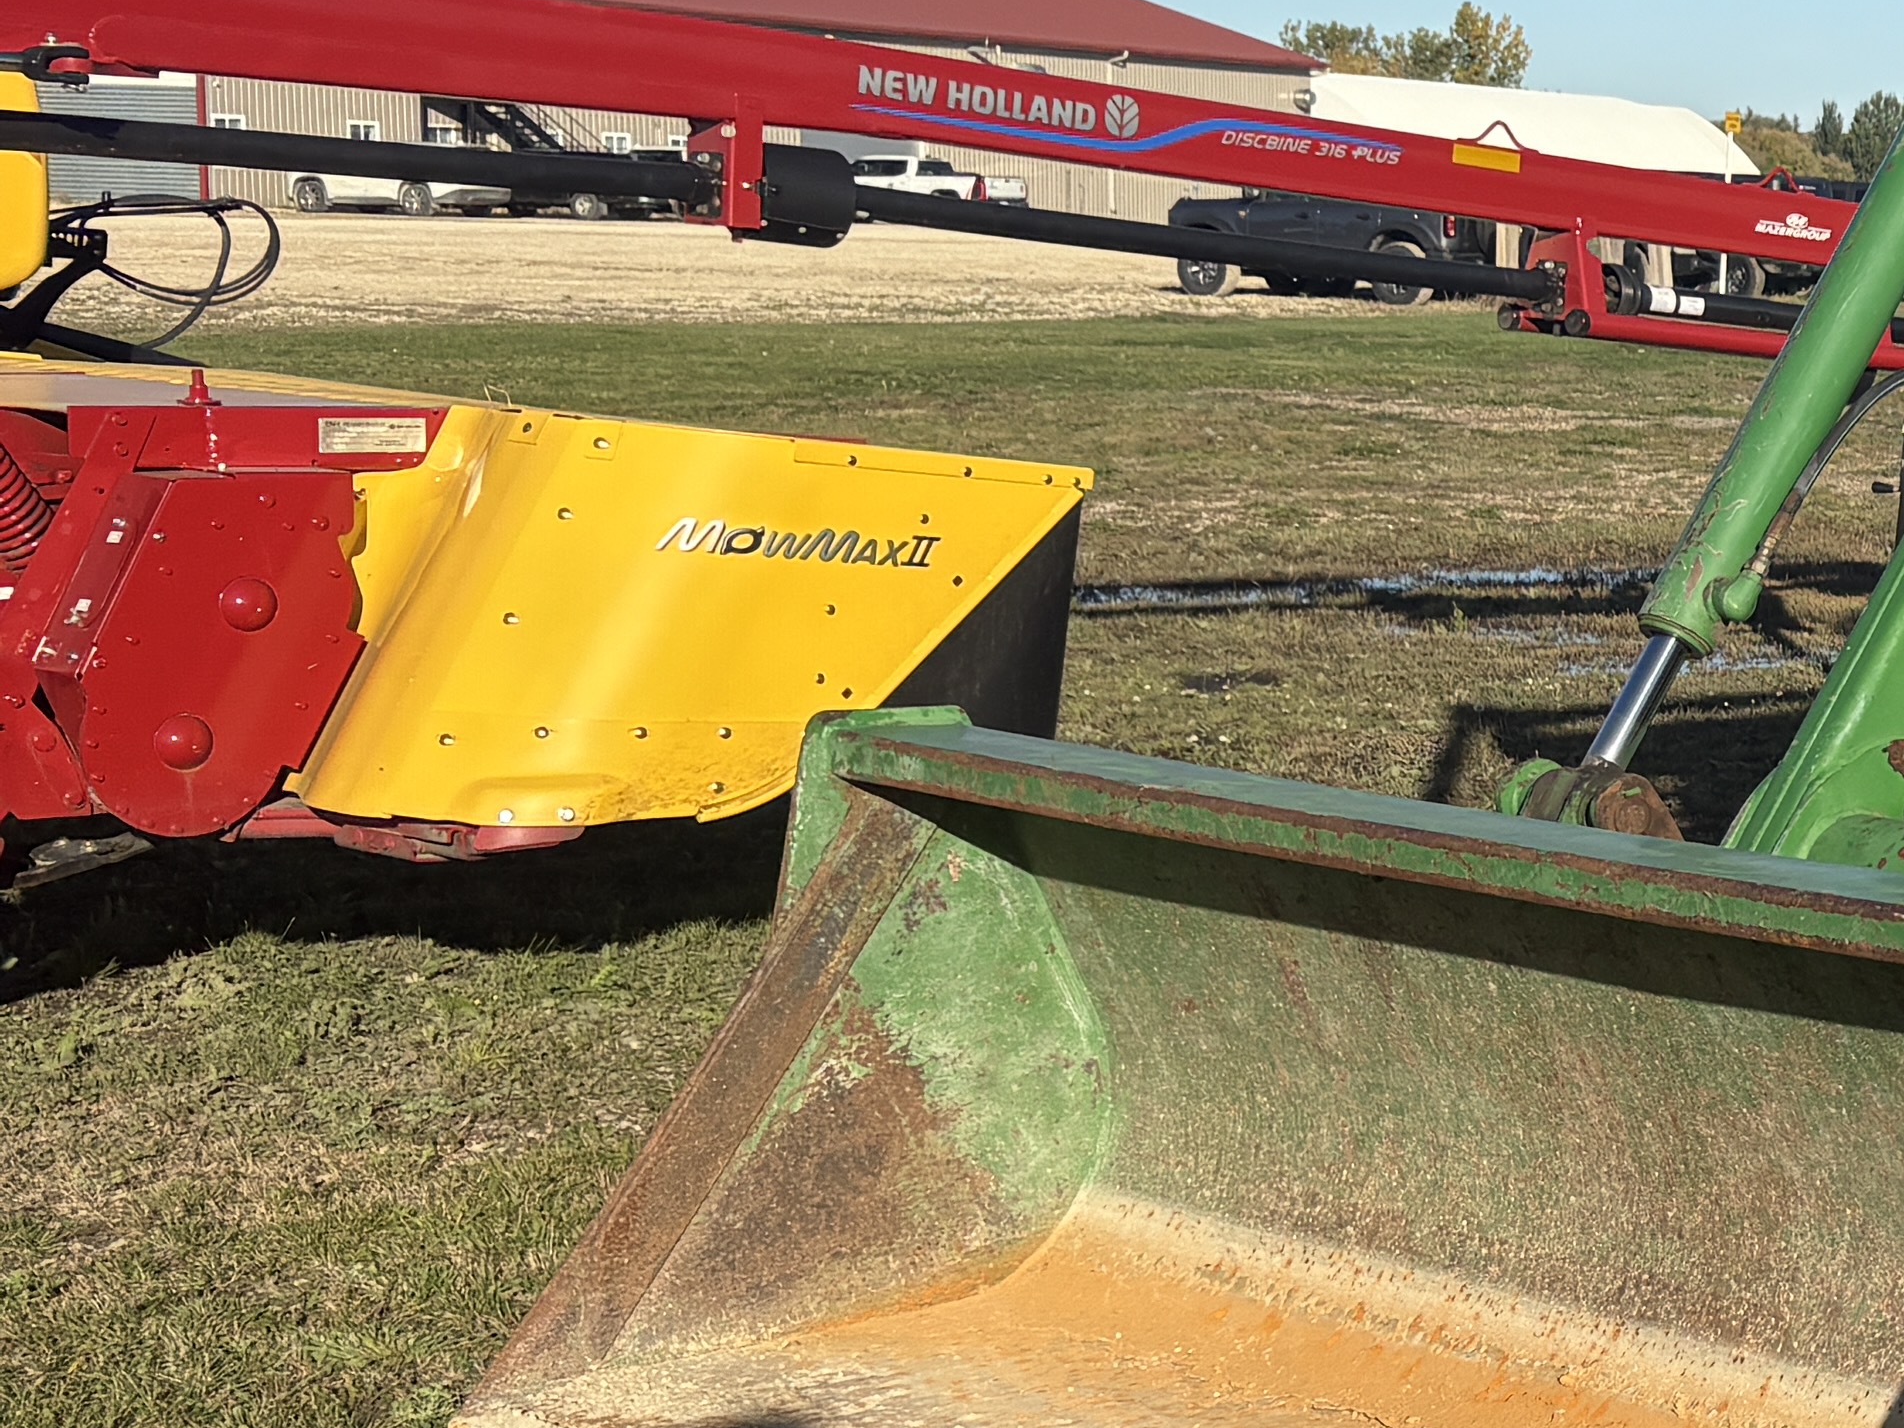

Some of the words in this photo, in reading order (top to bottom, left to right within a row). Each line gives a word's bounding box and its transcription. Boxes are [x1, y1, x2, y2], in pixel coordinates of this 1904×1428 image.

[858, 64, 938, 105] NEW
[947, 79, 1097, 131] HOLLAND
[1221, 130, 1312, 155] DISCBINE
[1314, 141, 1347, 159] 316
